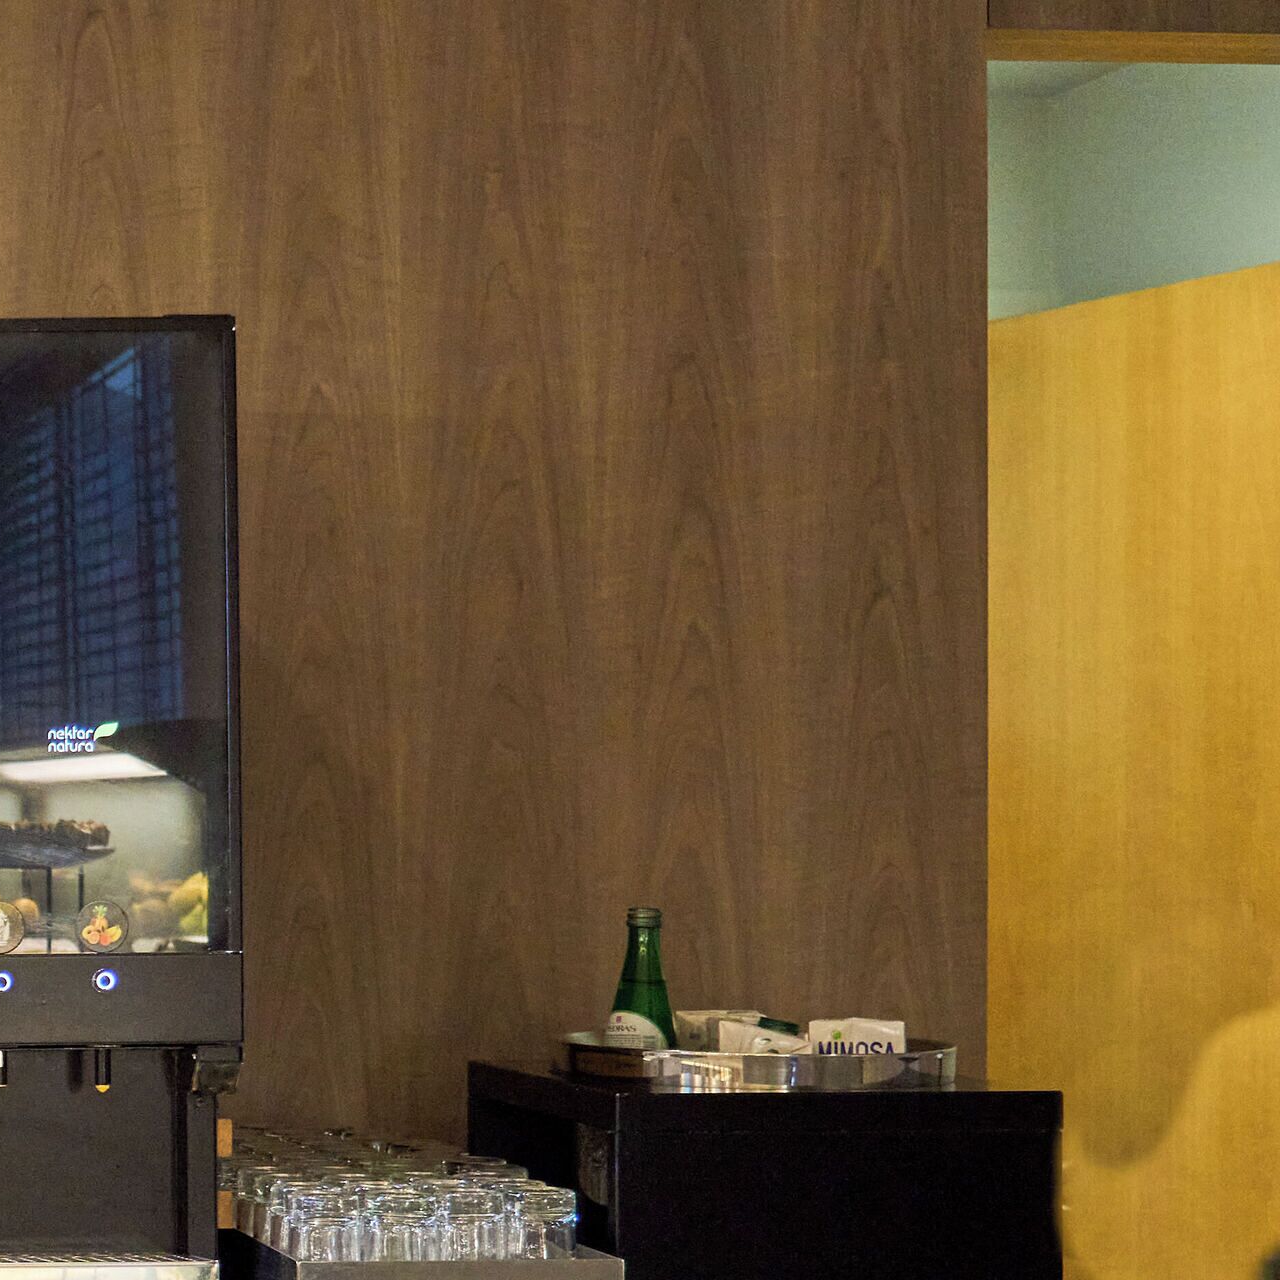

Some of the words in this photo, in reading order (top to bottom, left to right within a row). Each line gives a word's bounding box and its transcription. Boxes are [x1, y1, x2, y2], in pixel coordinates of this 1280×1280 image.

[47, 726, 94, 739] nektar
[47, 740, 94, 752] natura
[818, 1041, 894, 1054] MIMOSA
